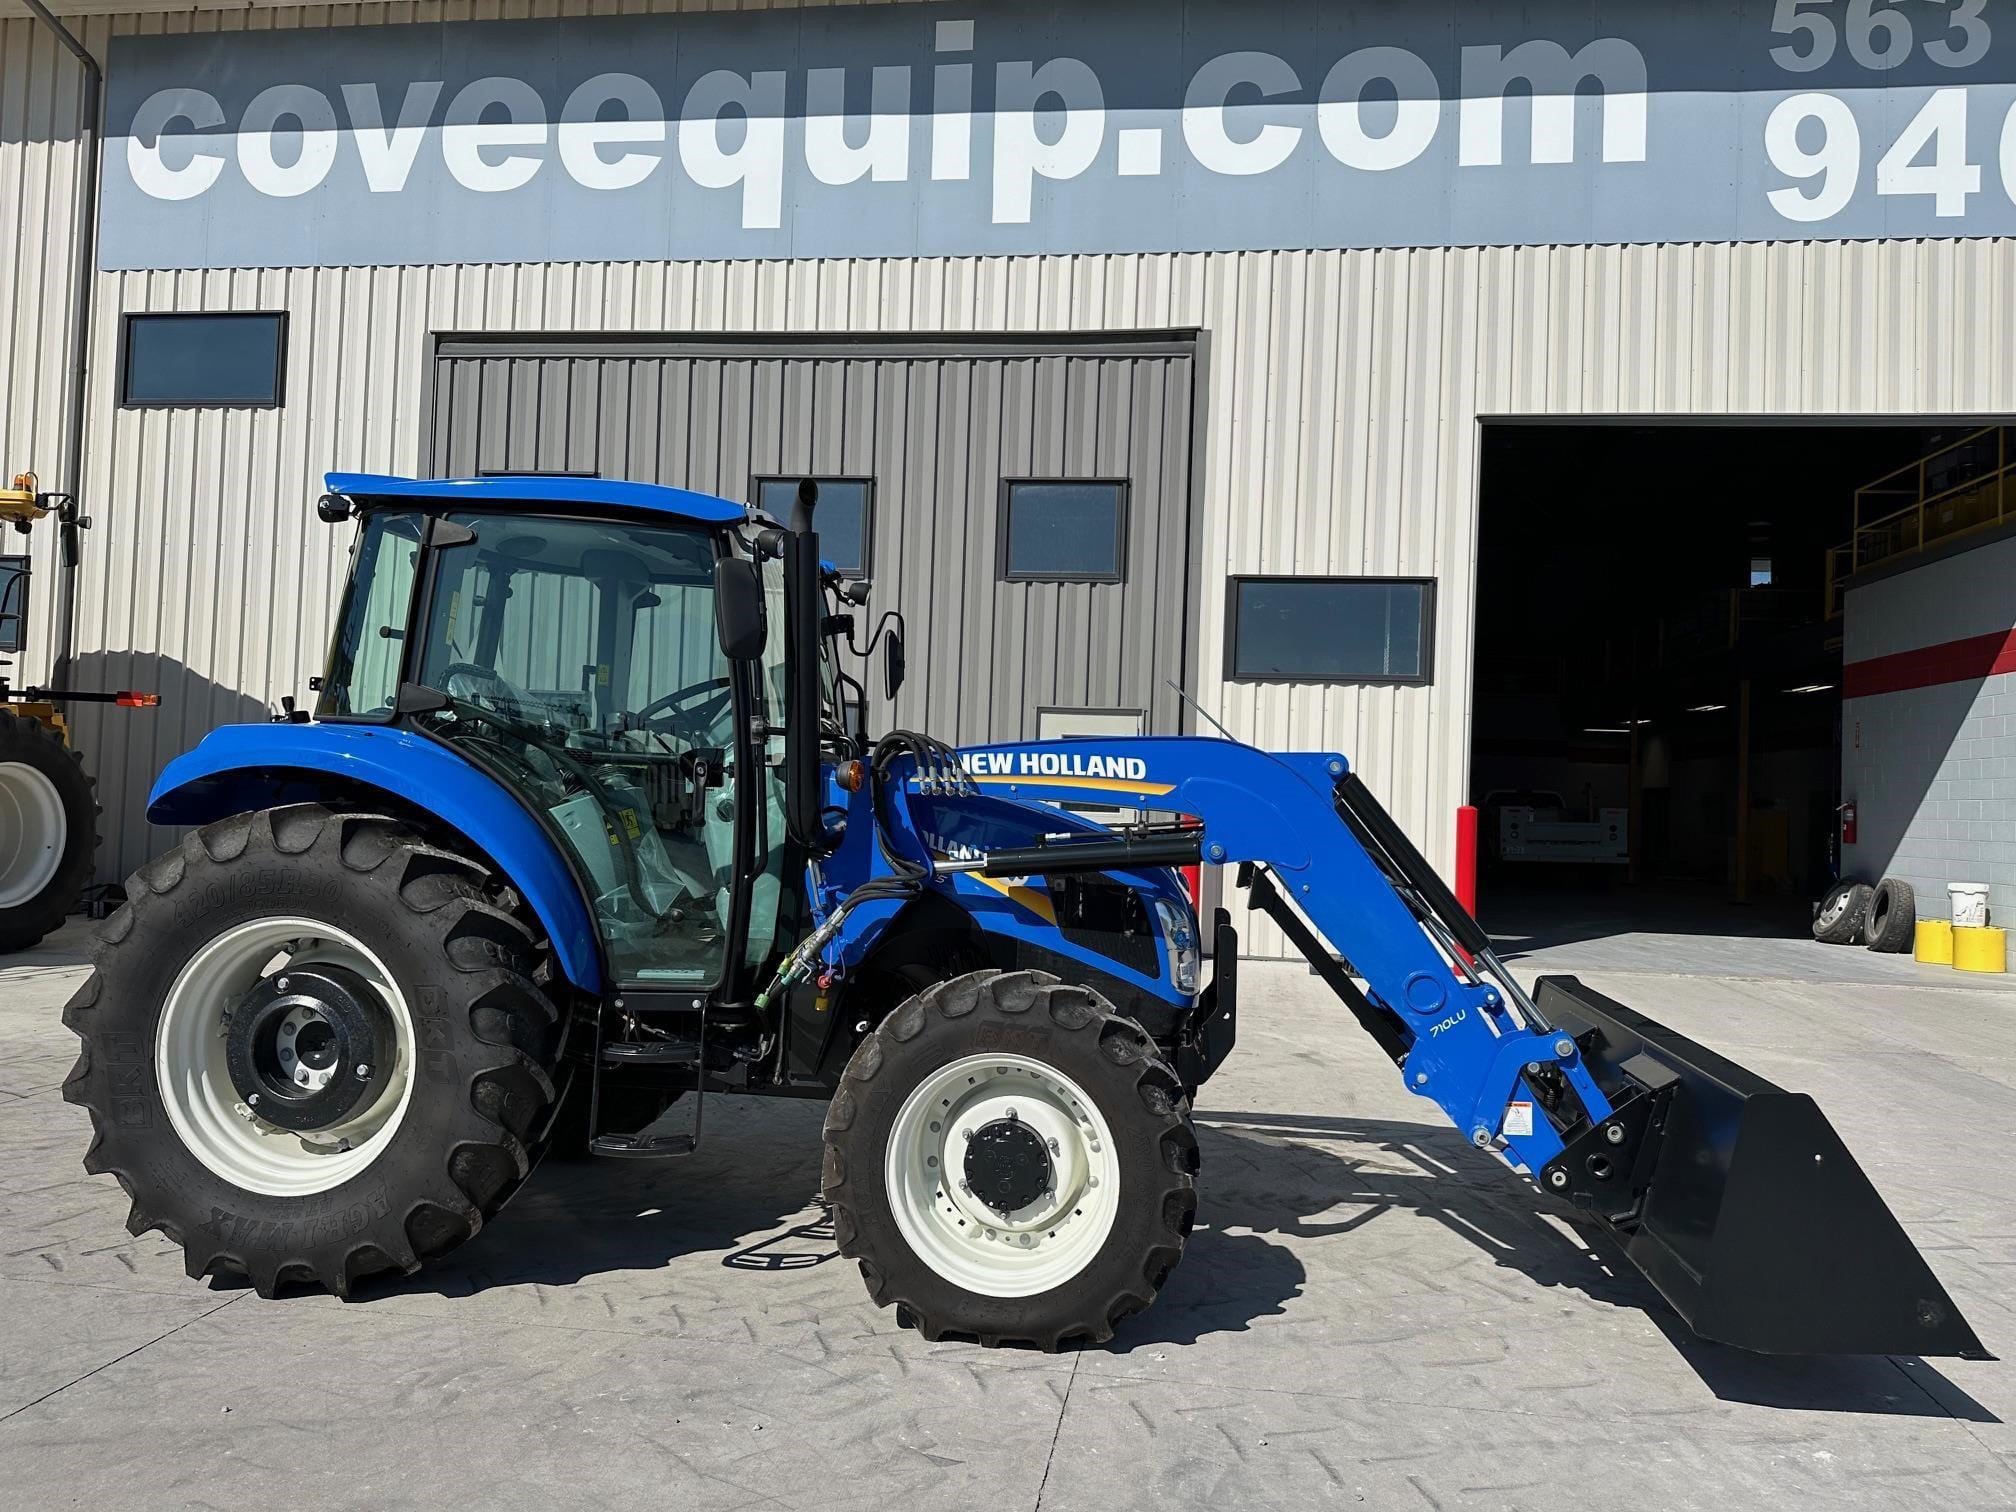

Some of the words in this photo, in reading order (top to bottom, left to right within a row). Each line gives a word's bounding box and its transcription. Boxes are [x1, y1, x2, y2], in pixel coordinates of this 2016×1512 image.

[1769, 0, 1992, 73] 563
[126, 19, 1648, 231] coveequip.com
[1764, 88, 2016, 222] 94
[952, 752, 1014, 775] NEW
[1020, 753, 1147, 780] HOLLAND
[1429, 1009, 1466, 1038] 710LU
